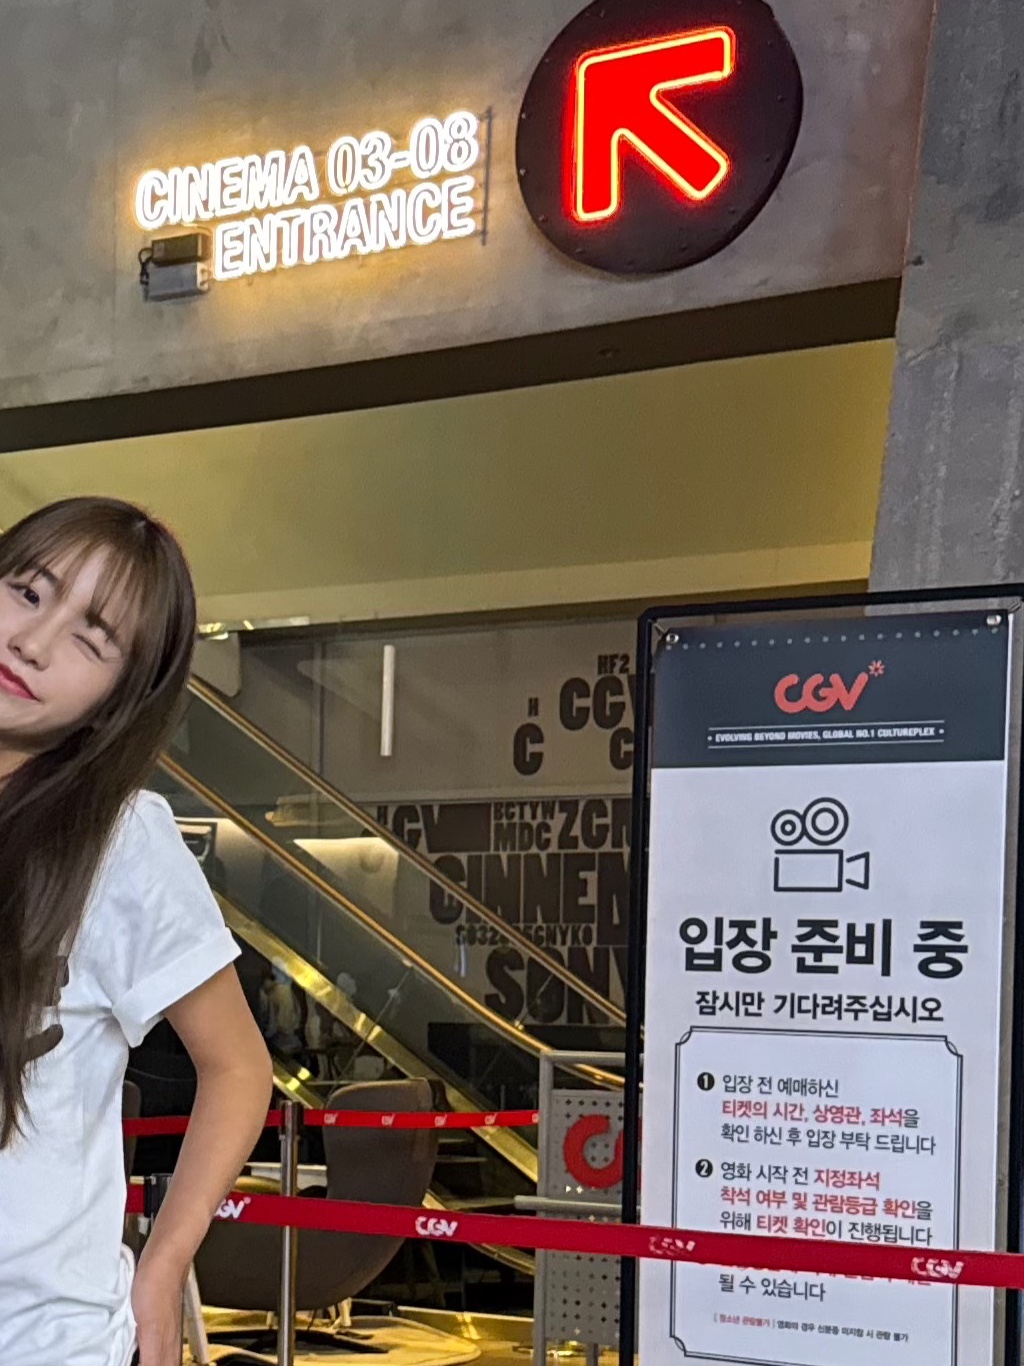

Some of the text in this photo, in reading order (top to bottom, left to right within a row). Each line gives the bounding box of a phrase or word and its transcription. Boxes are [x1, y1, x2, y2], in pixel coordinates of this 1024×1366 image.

[135, 110, 479, 231] CINEMA 03-08
[214, 174, 477, 280] ENTRANCE
[773, 672, 870, 714] CGV
[754, 731, 786, 742] BEYOND
[822, 729, 854, 740] GLOBAL
[877, 727, 935, 739] CULTUREPLEX
[678, 916, 969, 980] 입장 준비 중
[695, 989, 945, 1023] 잠시만 기다려주십시오
[722, 1074, 753, 1095] 입장
[757, 1075, 772, 1094] 전
[777, 1076, 839, 1098] 예매하신
[722, 1099, 919, 1129] 티켓의 시간, 상영관, 좌석을
[721, 1122, 936, 1156] 확인 하신 후 입장 부탁 드립니다
[720, 1161, 752, 1182] 영화
[756, 1163, 788, 1185] 시작
[792, 1165, 809, 1186] 전
[814, 1168, 881, 1191] 지정좌석
[214, 1198, 245, 1220] GV
[720, 1185, 933, 1221] 착석 여부 및 관람등급 확인을
[415, 1215, 459, 1238] CGV
[720, 1210, 933, 1247] 위해 티켓 확인이 진행됩니다
[910, 1256, 965, 1280] CGV
[718, 1273, 735, 1293] 될
[739, 1276, 756, 1295] 수
[760, 1277, 826, 1302] 있습니다
